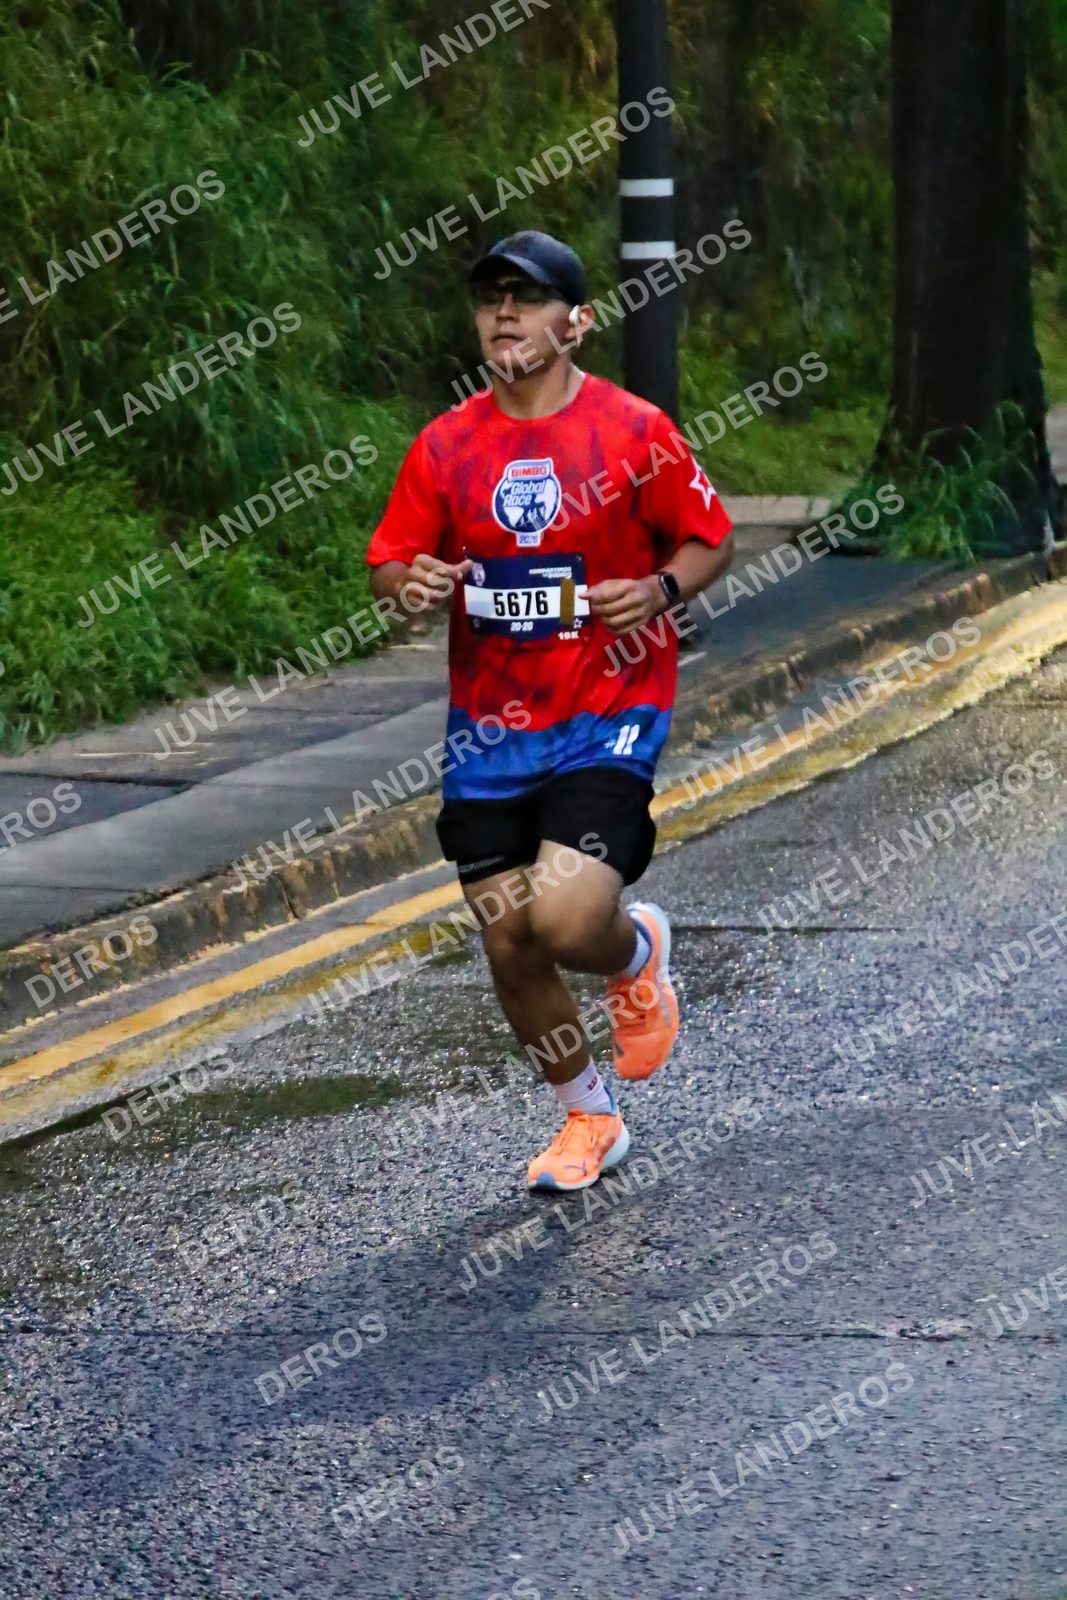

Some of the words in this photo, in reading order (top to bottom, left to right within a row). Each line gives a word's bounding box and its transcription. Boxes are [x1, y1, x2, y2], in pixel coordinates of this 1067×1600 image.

[510, 480, 546, 495] Global
[503, 494, 532, 507] Race
[493, 590, 549, 617] 5676
[558, 630, 580, 640] 10K
